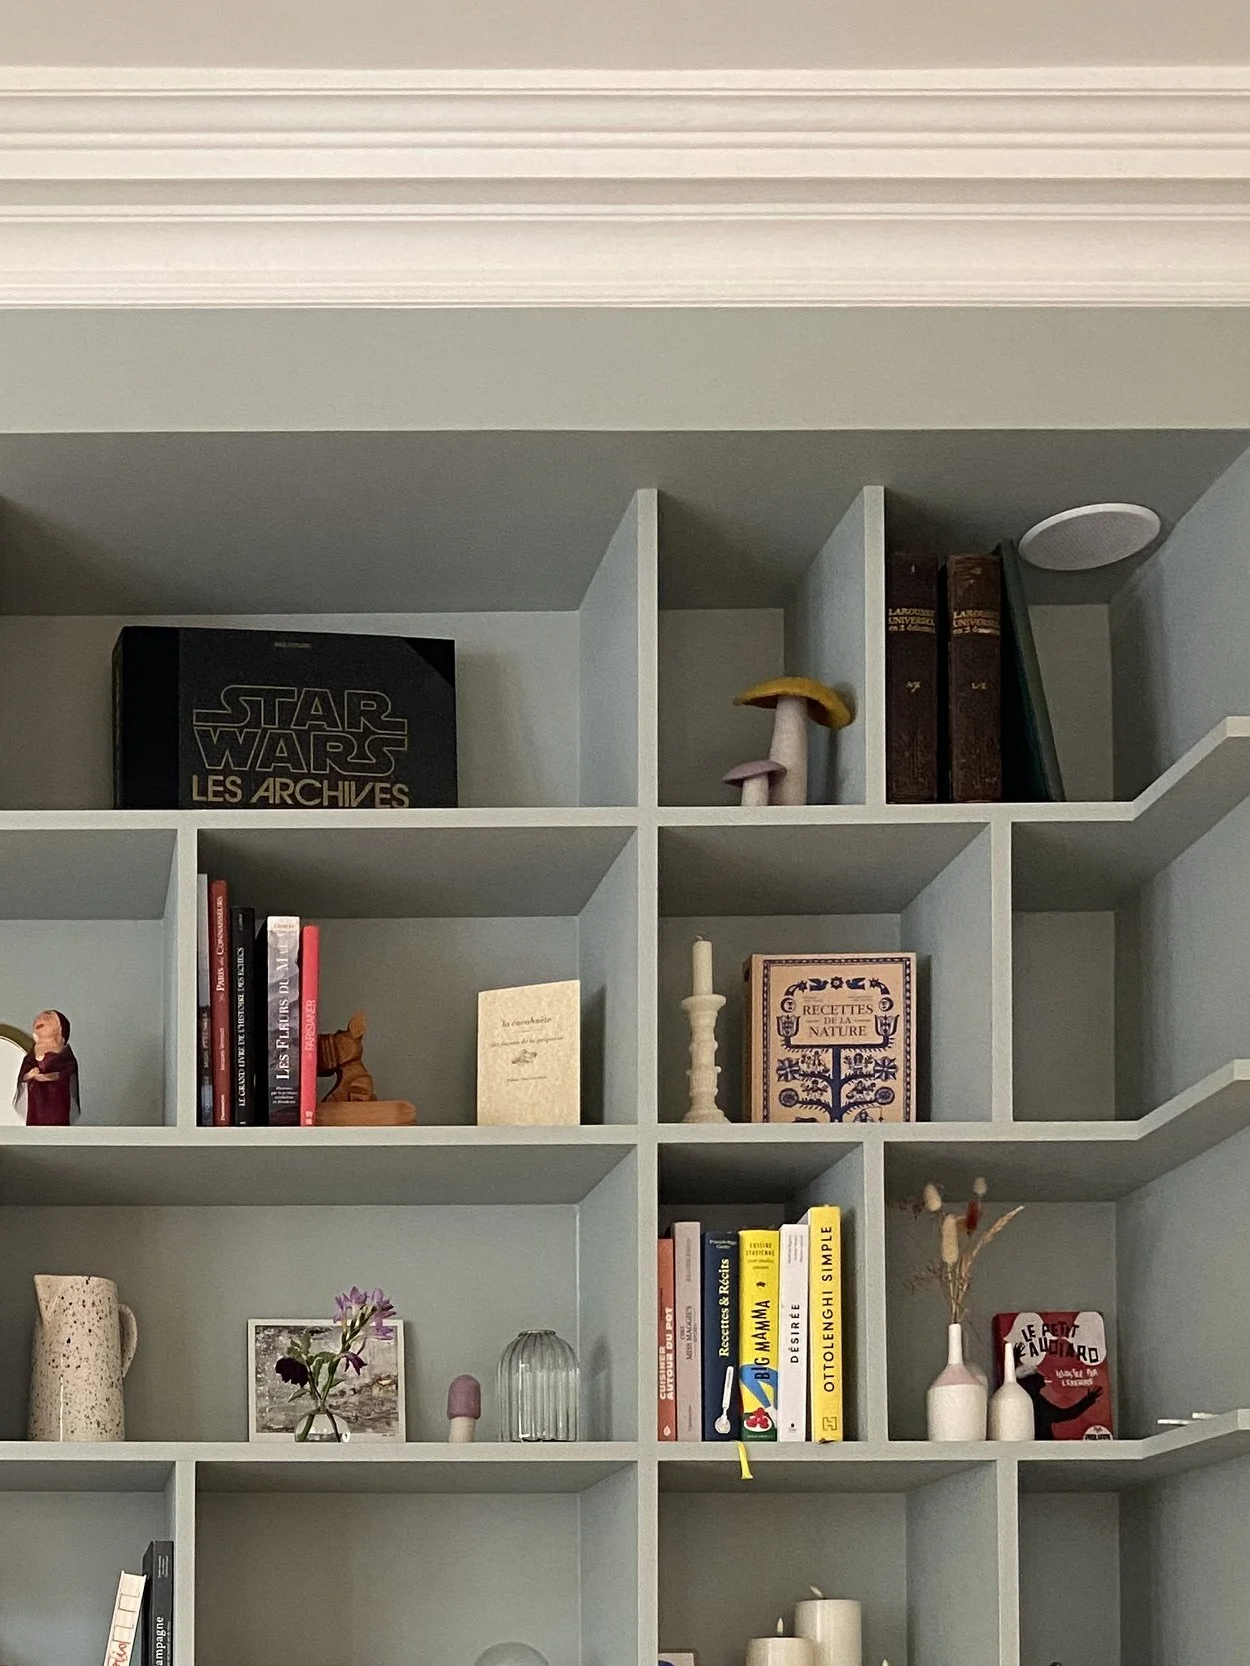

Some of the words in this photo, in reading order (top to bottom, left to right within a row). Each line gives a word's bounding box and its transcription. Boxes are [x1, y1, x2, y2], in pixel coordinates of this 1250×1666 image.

[193, 685, 407, 734] STAR
[194, 727, 407, 776] WARS
[192, 775, 242, 802] LES
[251, 777, 410, 808] ARCHIVES
[276, 943, 289, 971] MAL
[237, 977, 245, 991] DES
[280, 978, 290, 994] DU
[802, 1003, 873, 1016] RECETTES
[824, 1017, 837, 1025] DE
[276, 1000, 290, 1050] FLEURS
[809, 1026, 867, 1037] NATURE
[238, 1034, 245, 1045] DE
[276, 1054, 290, 1080] LES
[238, 1069, 246, 1096] GRAND
[238, 1097, 246, 1107] LE
[821, 1226, 833, 1282] SIMPLE
[717, 1258, 730, 1294] Récits
[718, 1296, 729, 1306] &
[667, 1331, 674, 1349] DU
[718, 1308, 730, 1358] Recettes
[751, 1300, 771, 1353] MAMMA
[789, 1304, 800, 1363] DÉSIRÉE
[1021, 1324, 1036, 1342] LE
[1042, 1322, 1080, 1339] PETIT
[822, 1291, 835, 1393] OTTOLENGHI
[666, 1351, 674, 1400] AUTOUR
[751, 1357, 770, 1380] BIG
